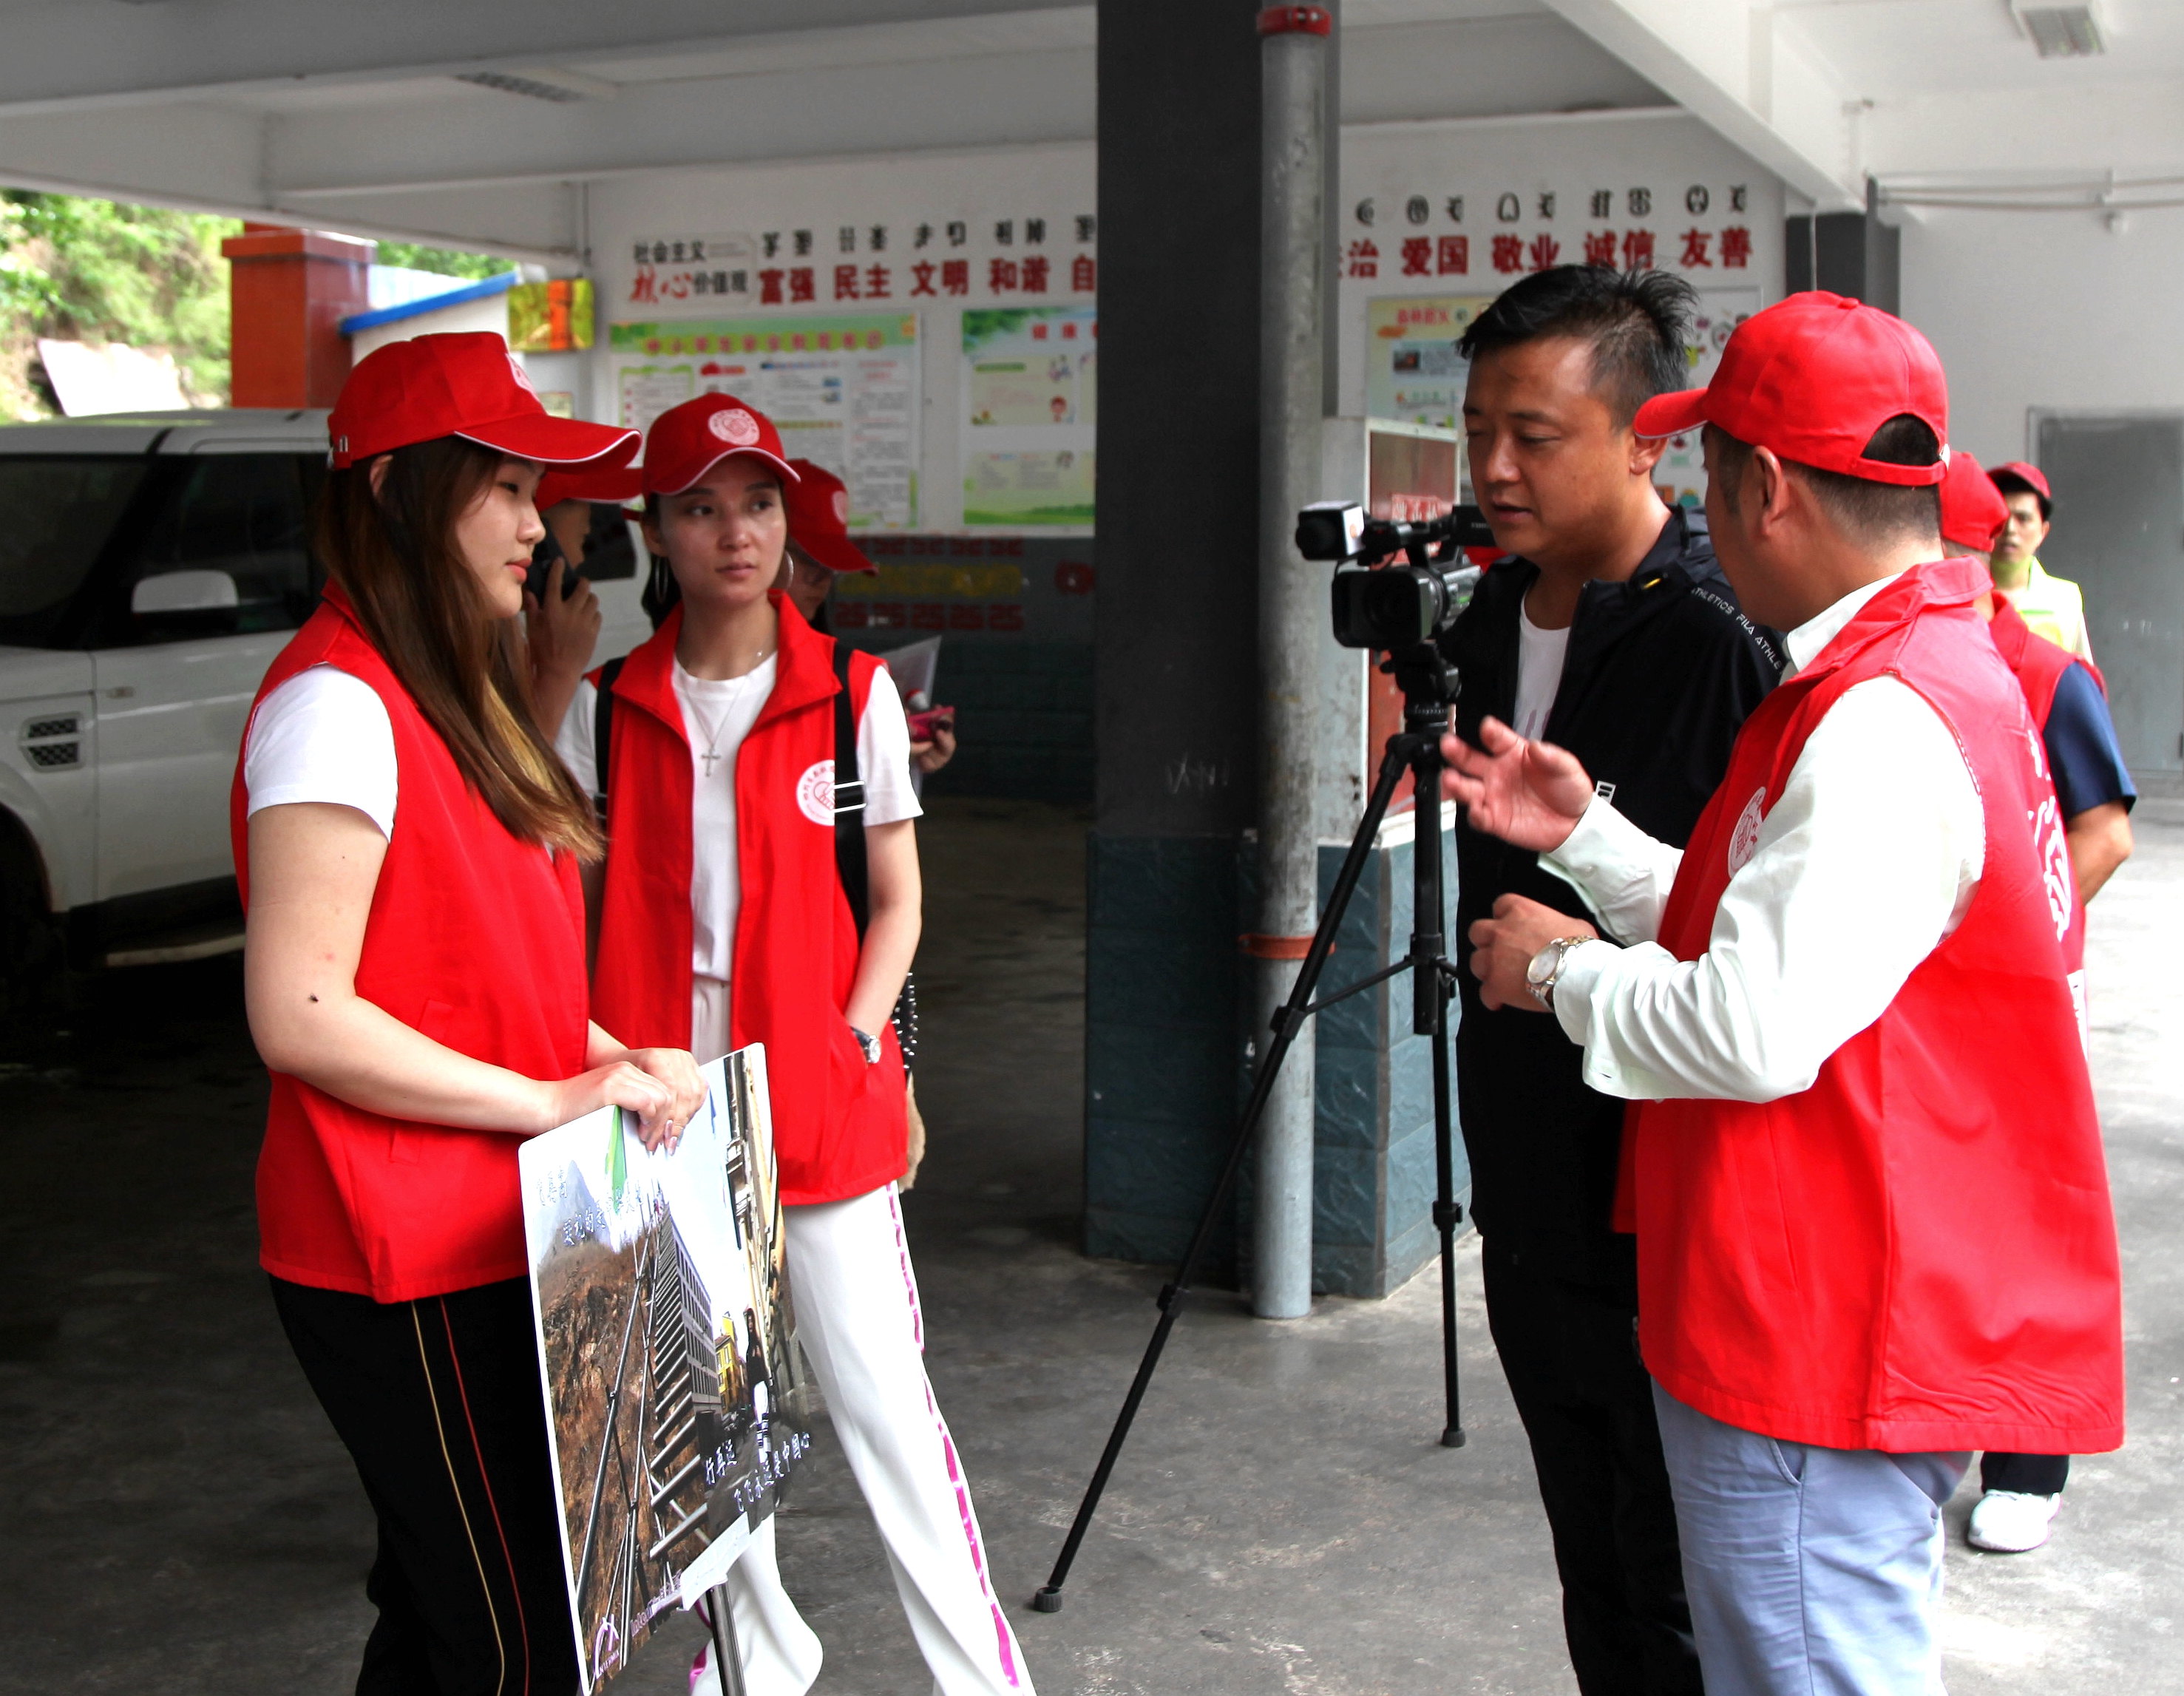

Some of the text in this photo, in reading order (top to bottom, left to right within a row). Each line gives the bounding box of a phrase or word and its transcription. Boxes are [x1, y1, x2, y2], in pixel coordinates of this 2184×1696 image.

[633, 239, 707, 264] 社会主义
[1339, 225, 1753, 279] 治 爱国 敬业 诚信 友善
[758, 253, 1096, 305] 富强 民主 文明 和谐 自
[1735, 613, 1755, 635] FILA
[1754, 636, 1783, 672] ATHLE
